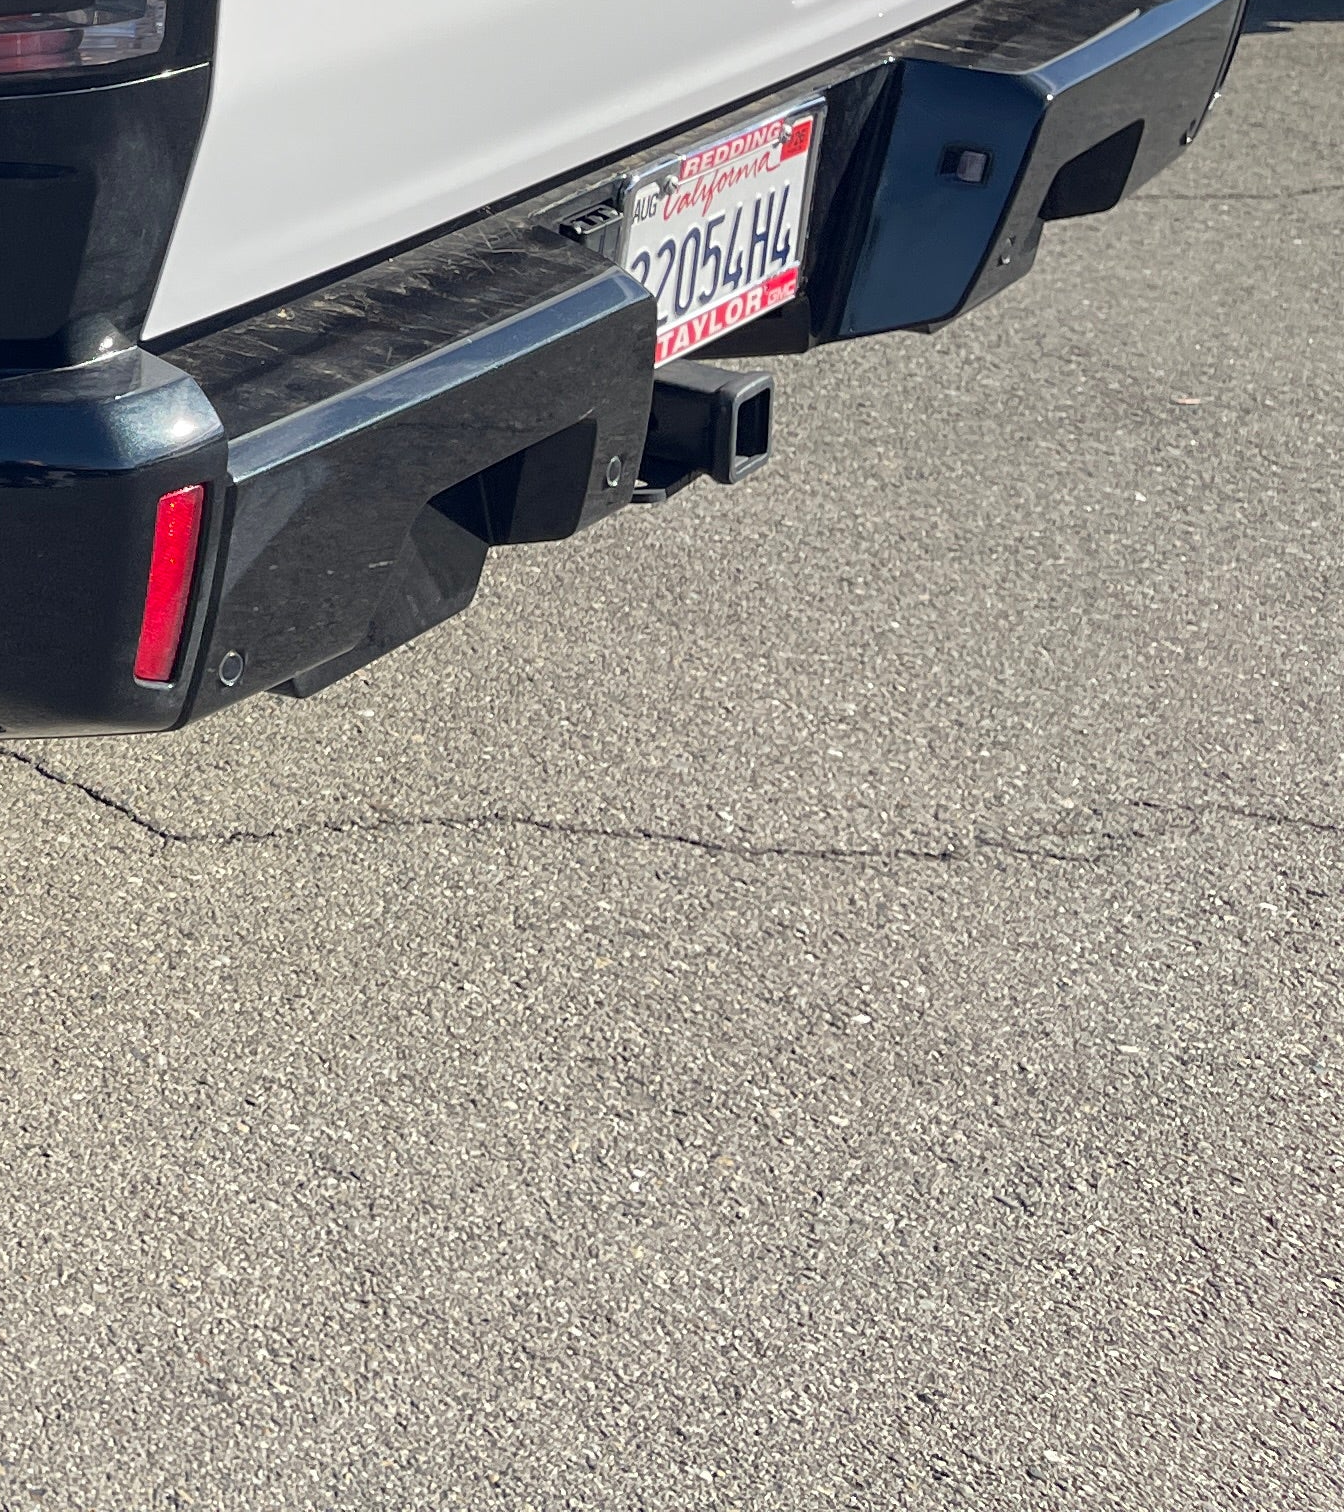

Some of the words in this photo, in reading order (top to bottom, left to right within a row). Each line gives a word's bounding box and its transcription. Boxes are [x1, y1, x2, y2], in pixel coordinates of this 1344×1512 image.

[683, 122, 781, 178] REDDING
[632, 192, 659, 223] AUG
[663, 151, 781, 221] California
[657, 287, 764, 359] TAYLOR
